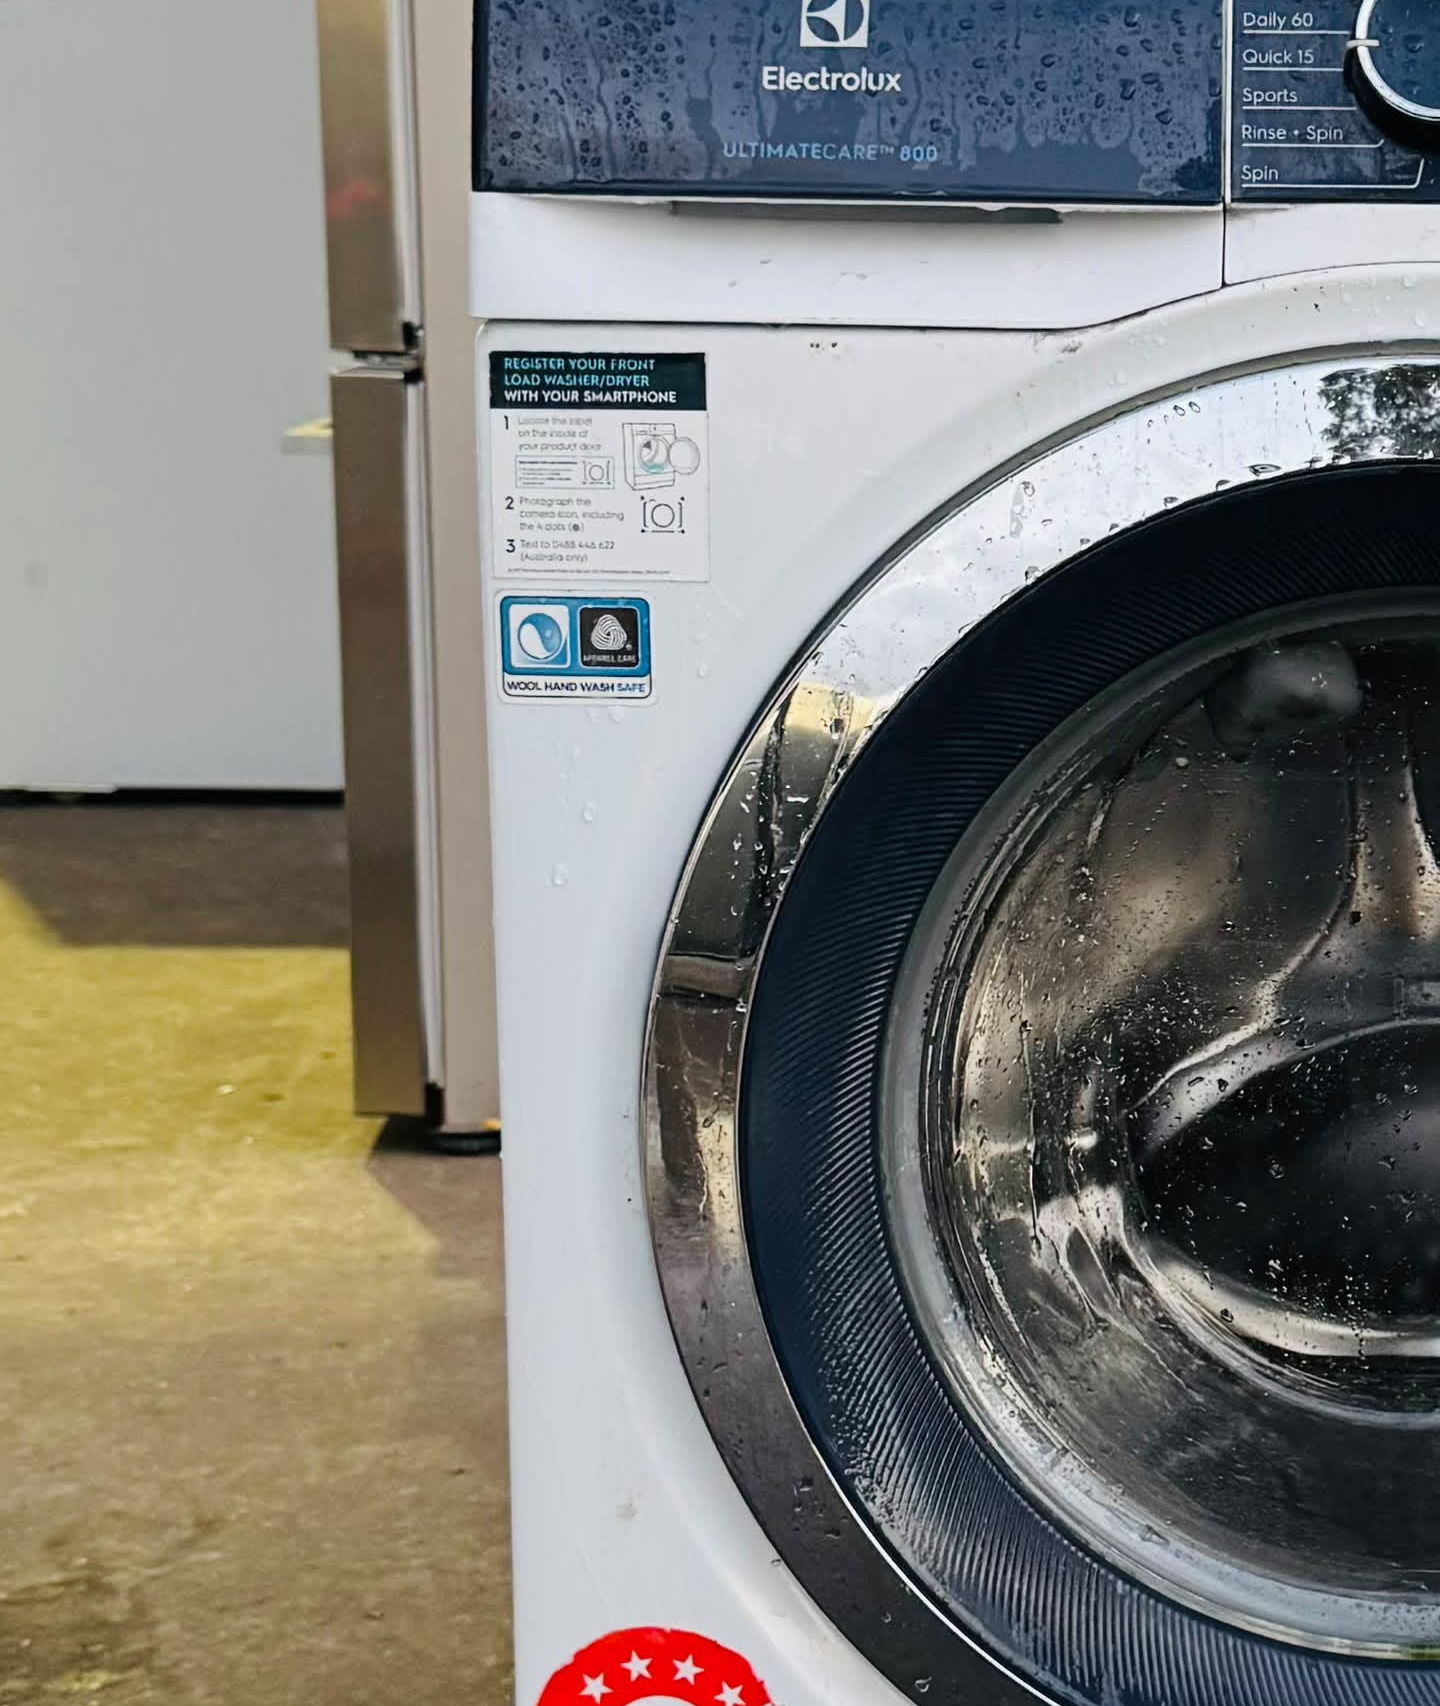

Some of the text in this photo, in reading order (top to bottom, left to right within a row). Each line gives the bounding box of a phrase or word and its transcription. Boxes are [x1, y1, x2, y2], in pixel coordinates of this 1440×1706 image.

[1243, 12, 1314, 30] Daily 60
[1242, 49, 1314, 64] Quick 15
[762, 66, 901, 91] Electrolux
[1242, 88, 1298, 106] Sports
[1242, 125, 1287, 140] Rinse
[1306, 126, 1343, 143] Spin
[900, 146, 938, 162] 800
[1241, 165, 1279, 183] Spin
[504, 358, 655, 370] REGISTER YOUR FRONT
[505, 375, 650, 387] LOAD WASHER/DRYER
[505, 391, 677, 403] WITH YOUR SMARTPHONE
[504, 415, 509, 429] 1
[505, 496, 514, 509] 2
[506, 539, 515, 553] 3
[507, 681, 646, 692] WOOL HAND WASH SAFE
